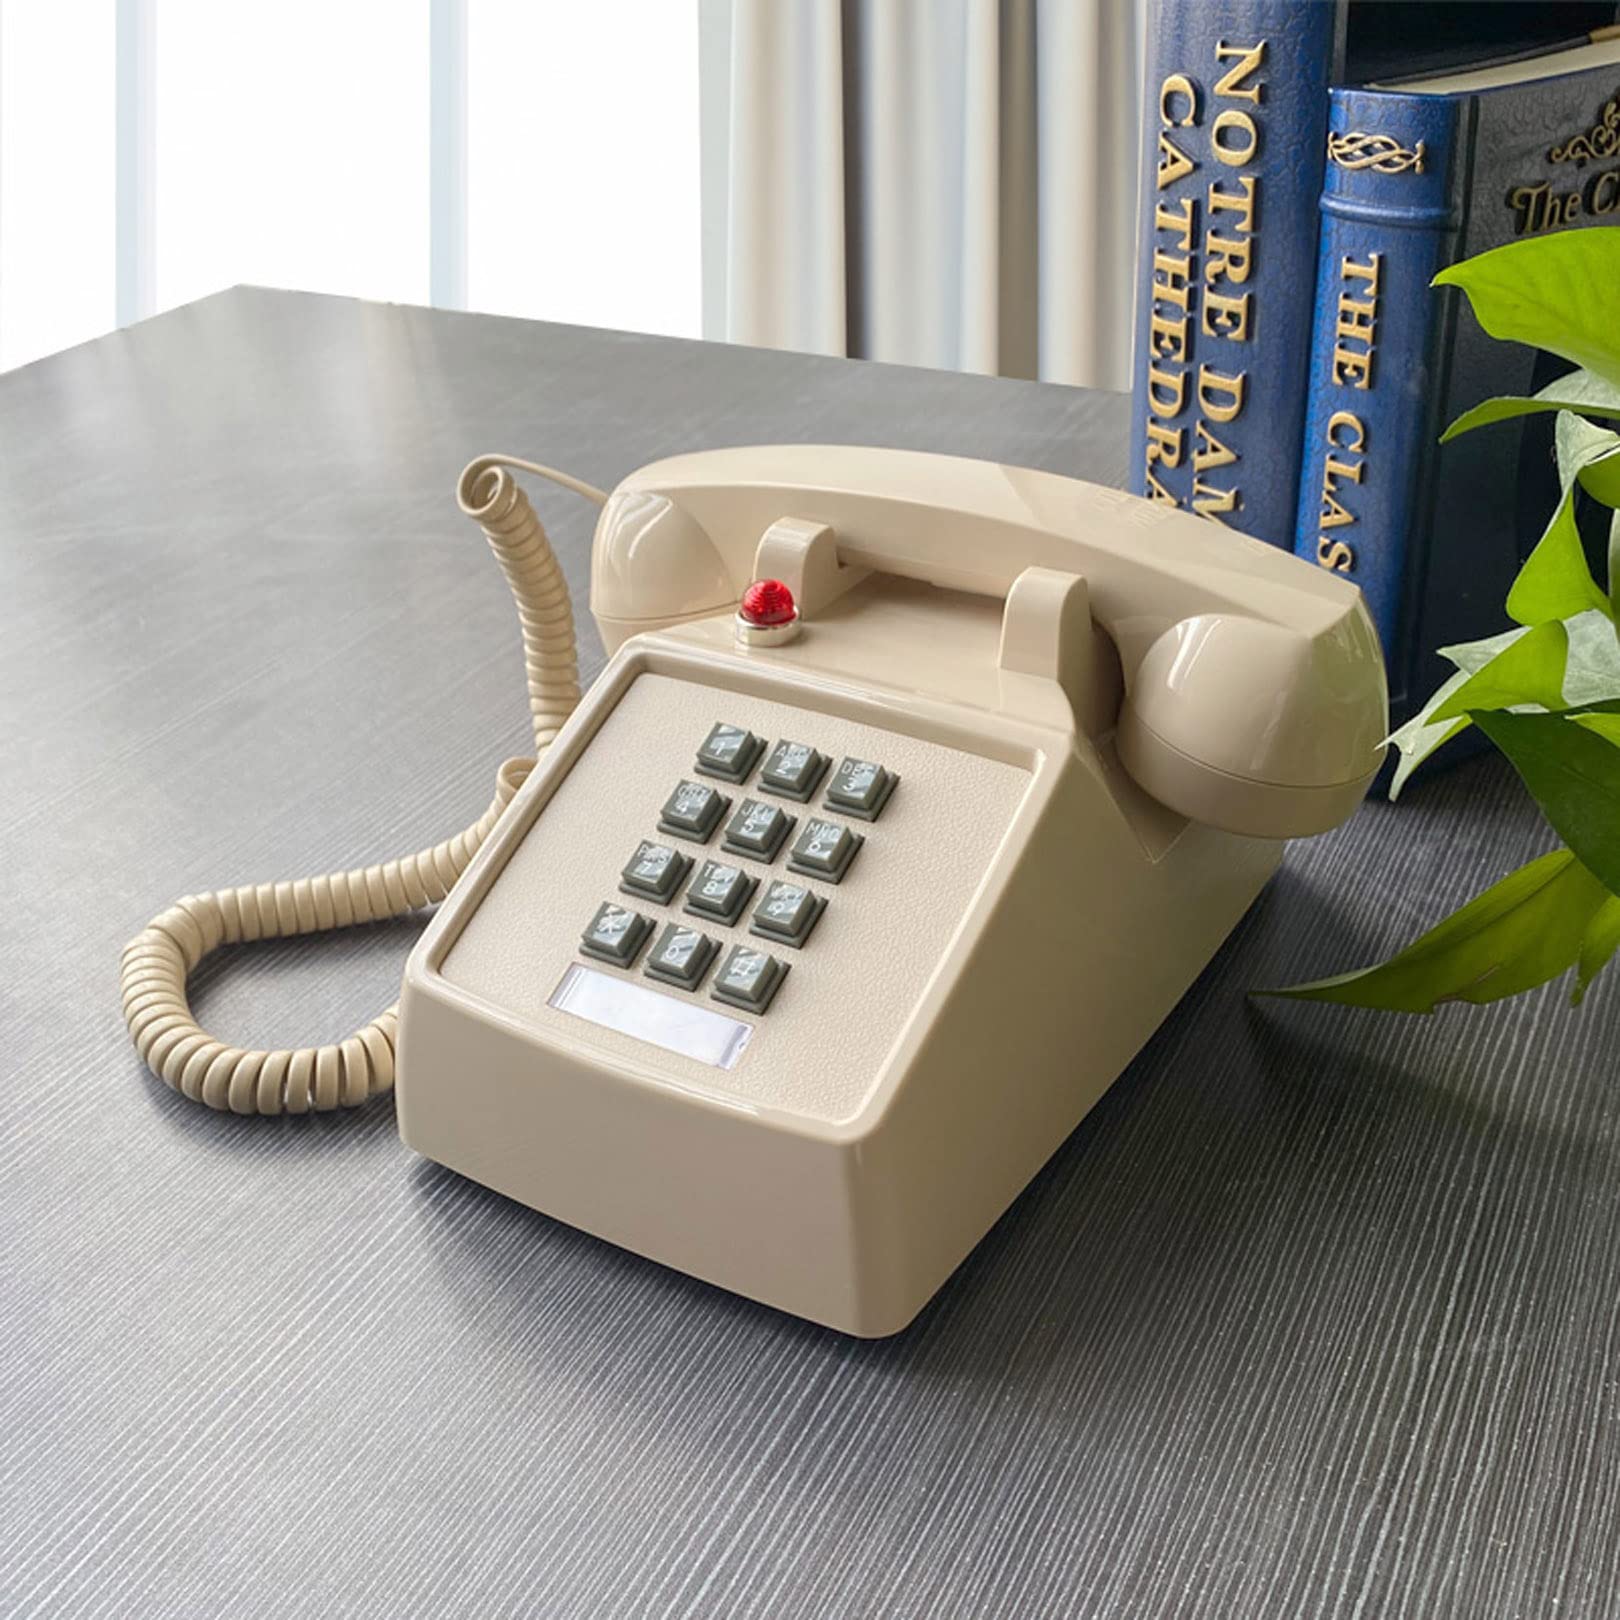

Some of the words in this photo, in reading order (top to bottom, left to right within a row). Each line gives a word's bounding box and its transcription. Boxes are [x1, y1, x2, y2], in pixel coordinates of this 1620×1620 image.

[1202, 40, 1267, 342] NOTRE
[1512, 181, 1582, 236] The
[1333, 252, 1382, 391] THE
[1317, 411, 1366, 572] CLAS
[776, 760, 792, 775] 2
[842, 777, 857, 792] 3
[742, 818, 755, 833] 5
[640, 860, 653, 875] 7
[702, 880, 718, 895] 8
[767, 900, 785, 916] 9
